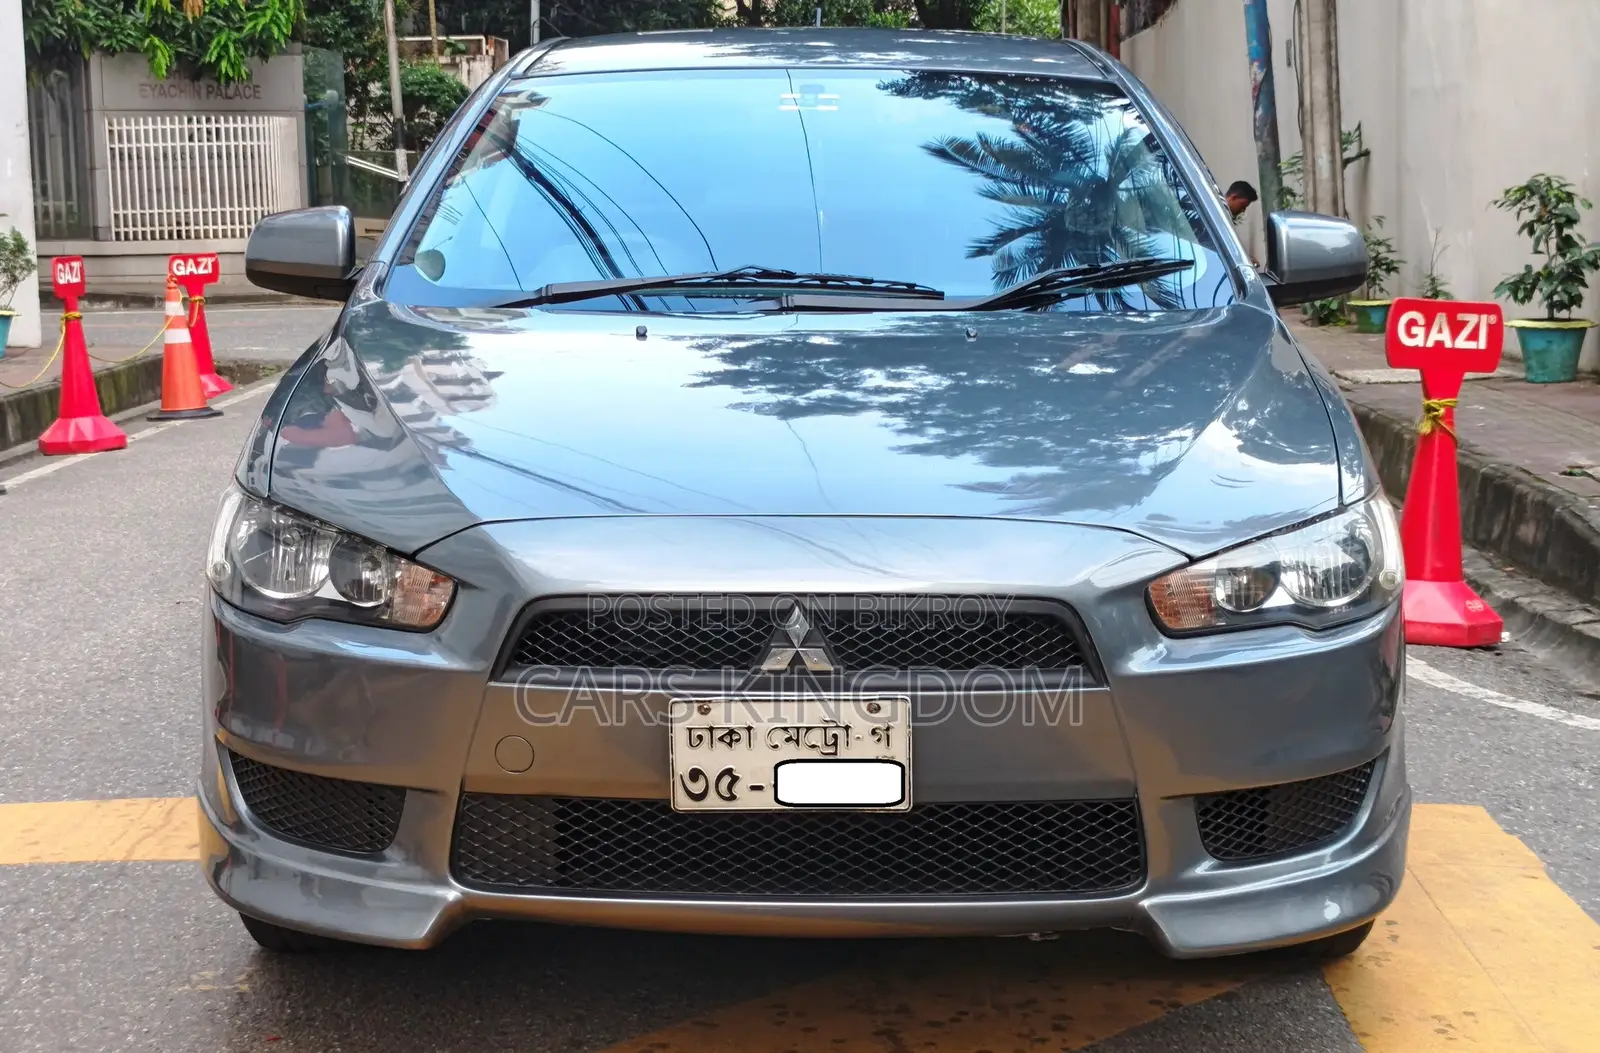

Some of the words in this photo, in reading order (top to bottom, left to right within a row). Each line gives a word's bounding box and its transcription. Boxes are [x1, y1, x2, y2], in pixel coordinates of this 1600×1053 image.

[138, 82, 202, 100] EYACHIN
[206, 83, 262, 100] PALACE
[57, 261, 82, 285] GAZI
[172, 256, 214, 276] GAZI
[685, 722, 754, 750] ঢাকা
